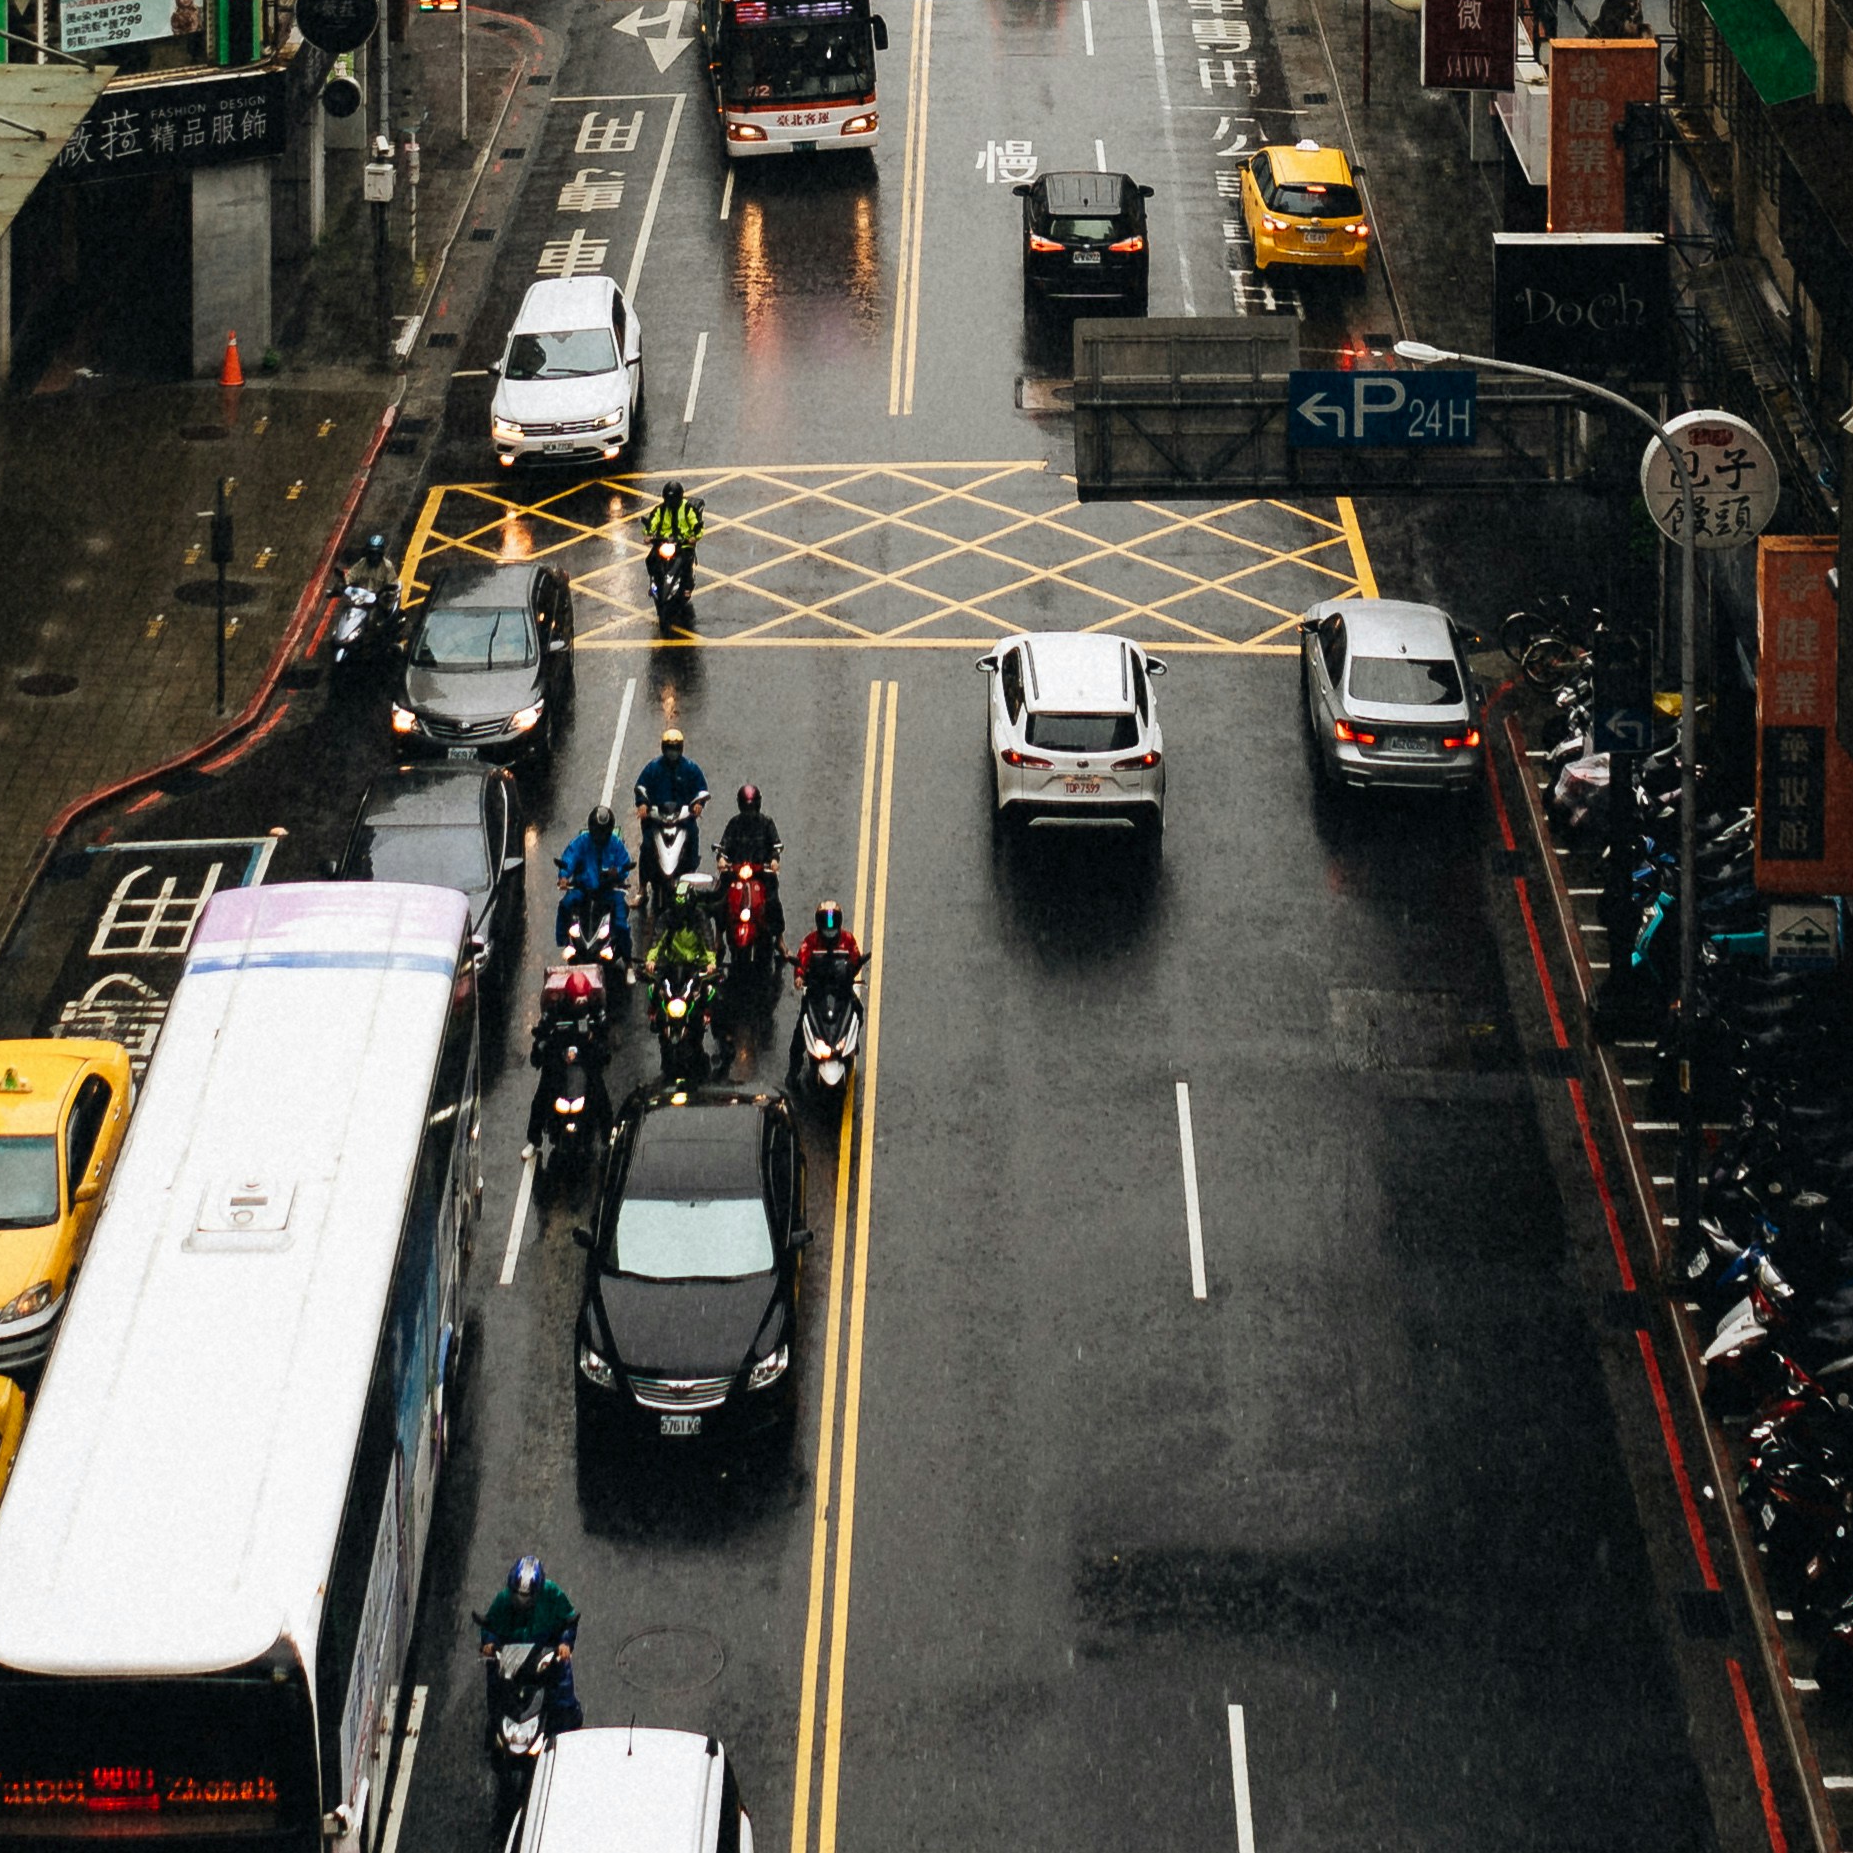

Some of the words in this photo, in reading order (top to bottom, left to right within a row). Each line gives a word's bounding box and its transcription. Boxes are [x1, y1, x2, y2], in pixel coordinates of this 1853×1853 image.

[1447, 54, 1491, 79] SAVVY
[150, 102, 206, 119] FASHION
[220, 95, 266, 110] DESIGN
[150, 108, 267, 153] 精品服飾
[975, 140, 1038, 183] 慢
[1354, 378, 1406, 437] P
[1409, 399, 1470, 437] 24H
[1669, 449, 1757, 490] 包子
